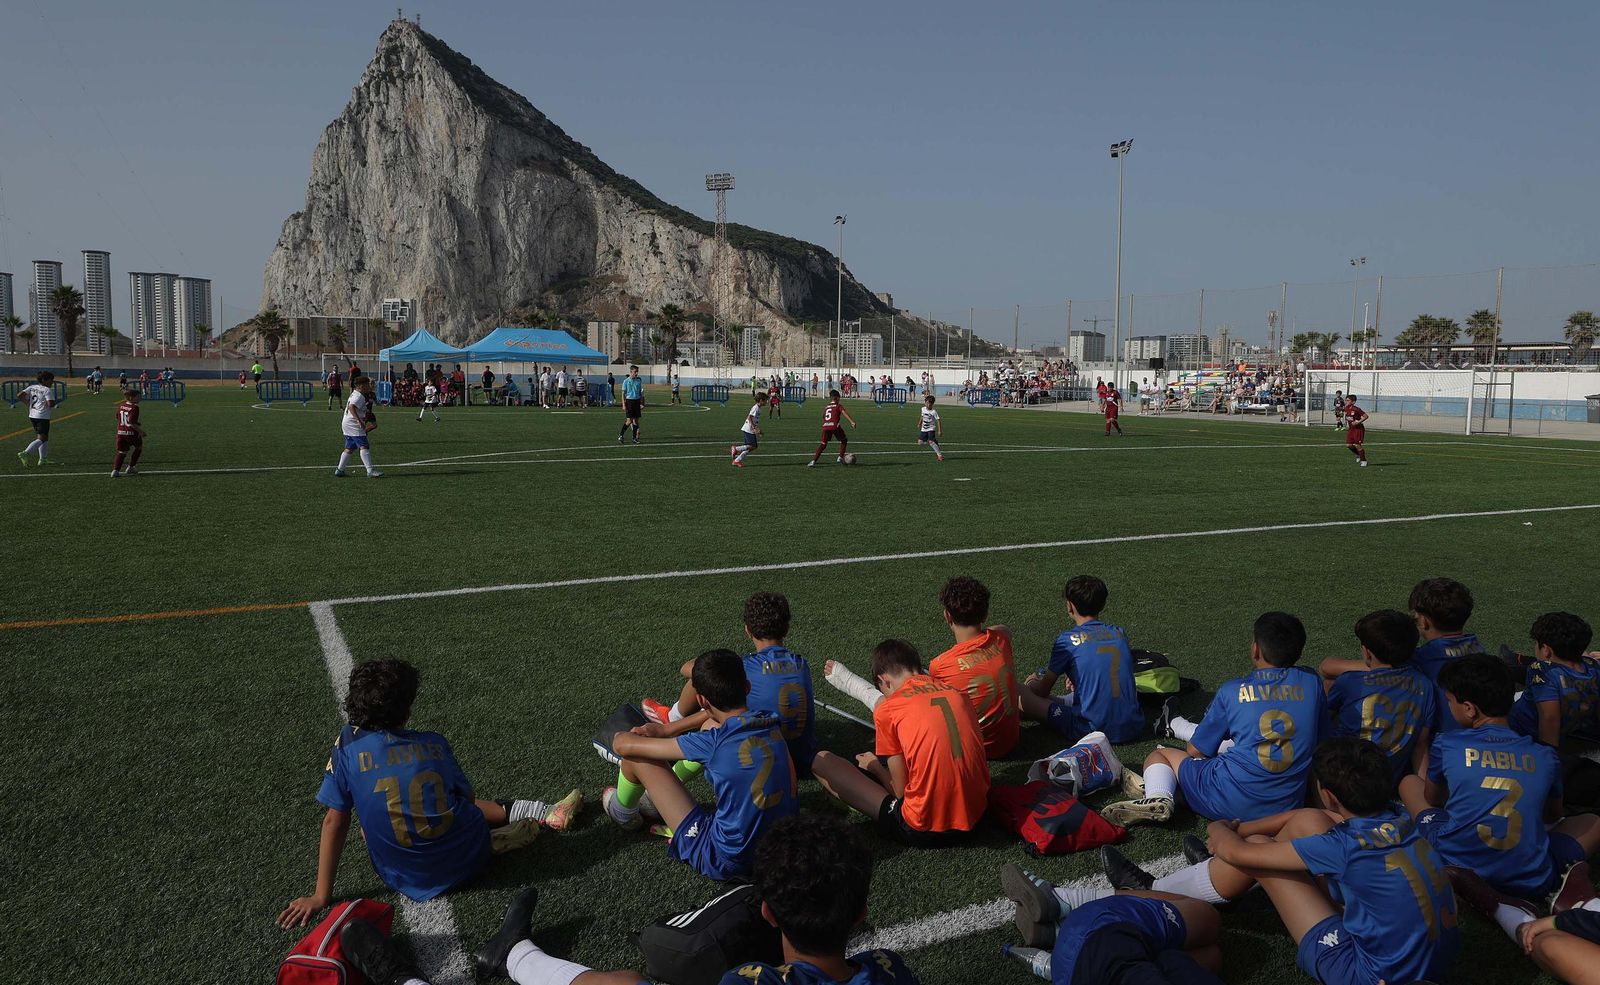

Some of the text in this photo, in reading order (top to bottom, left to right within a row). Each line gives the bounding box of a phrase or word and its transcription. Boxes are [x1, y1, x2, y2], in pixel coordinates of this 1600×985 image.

[824, 408, 832, 421] 5
[1096, 645, 1120, 699] 7
[1238, 683, 1305, 703] ÁLVARO
[778, 683, 808, 740] 9
[930, 697, 963, 758] 1
[359, 751, 380, 773] D.
[1257, 709, 1295, 773] 8
[1465, 747, 1536, 773] PABLO
[373, 771, 455, 848] 10
[1477, 776, 1524, 851] 3
